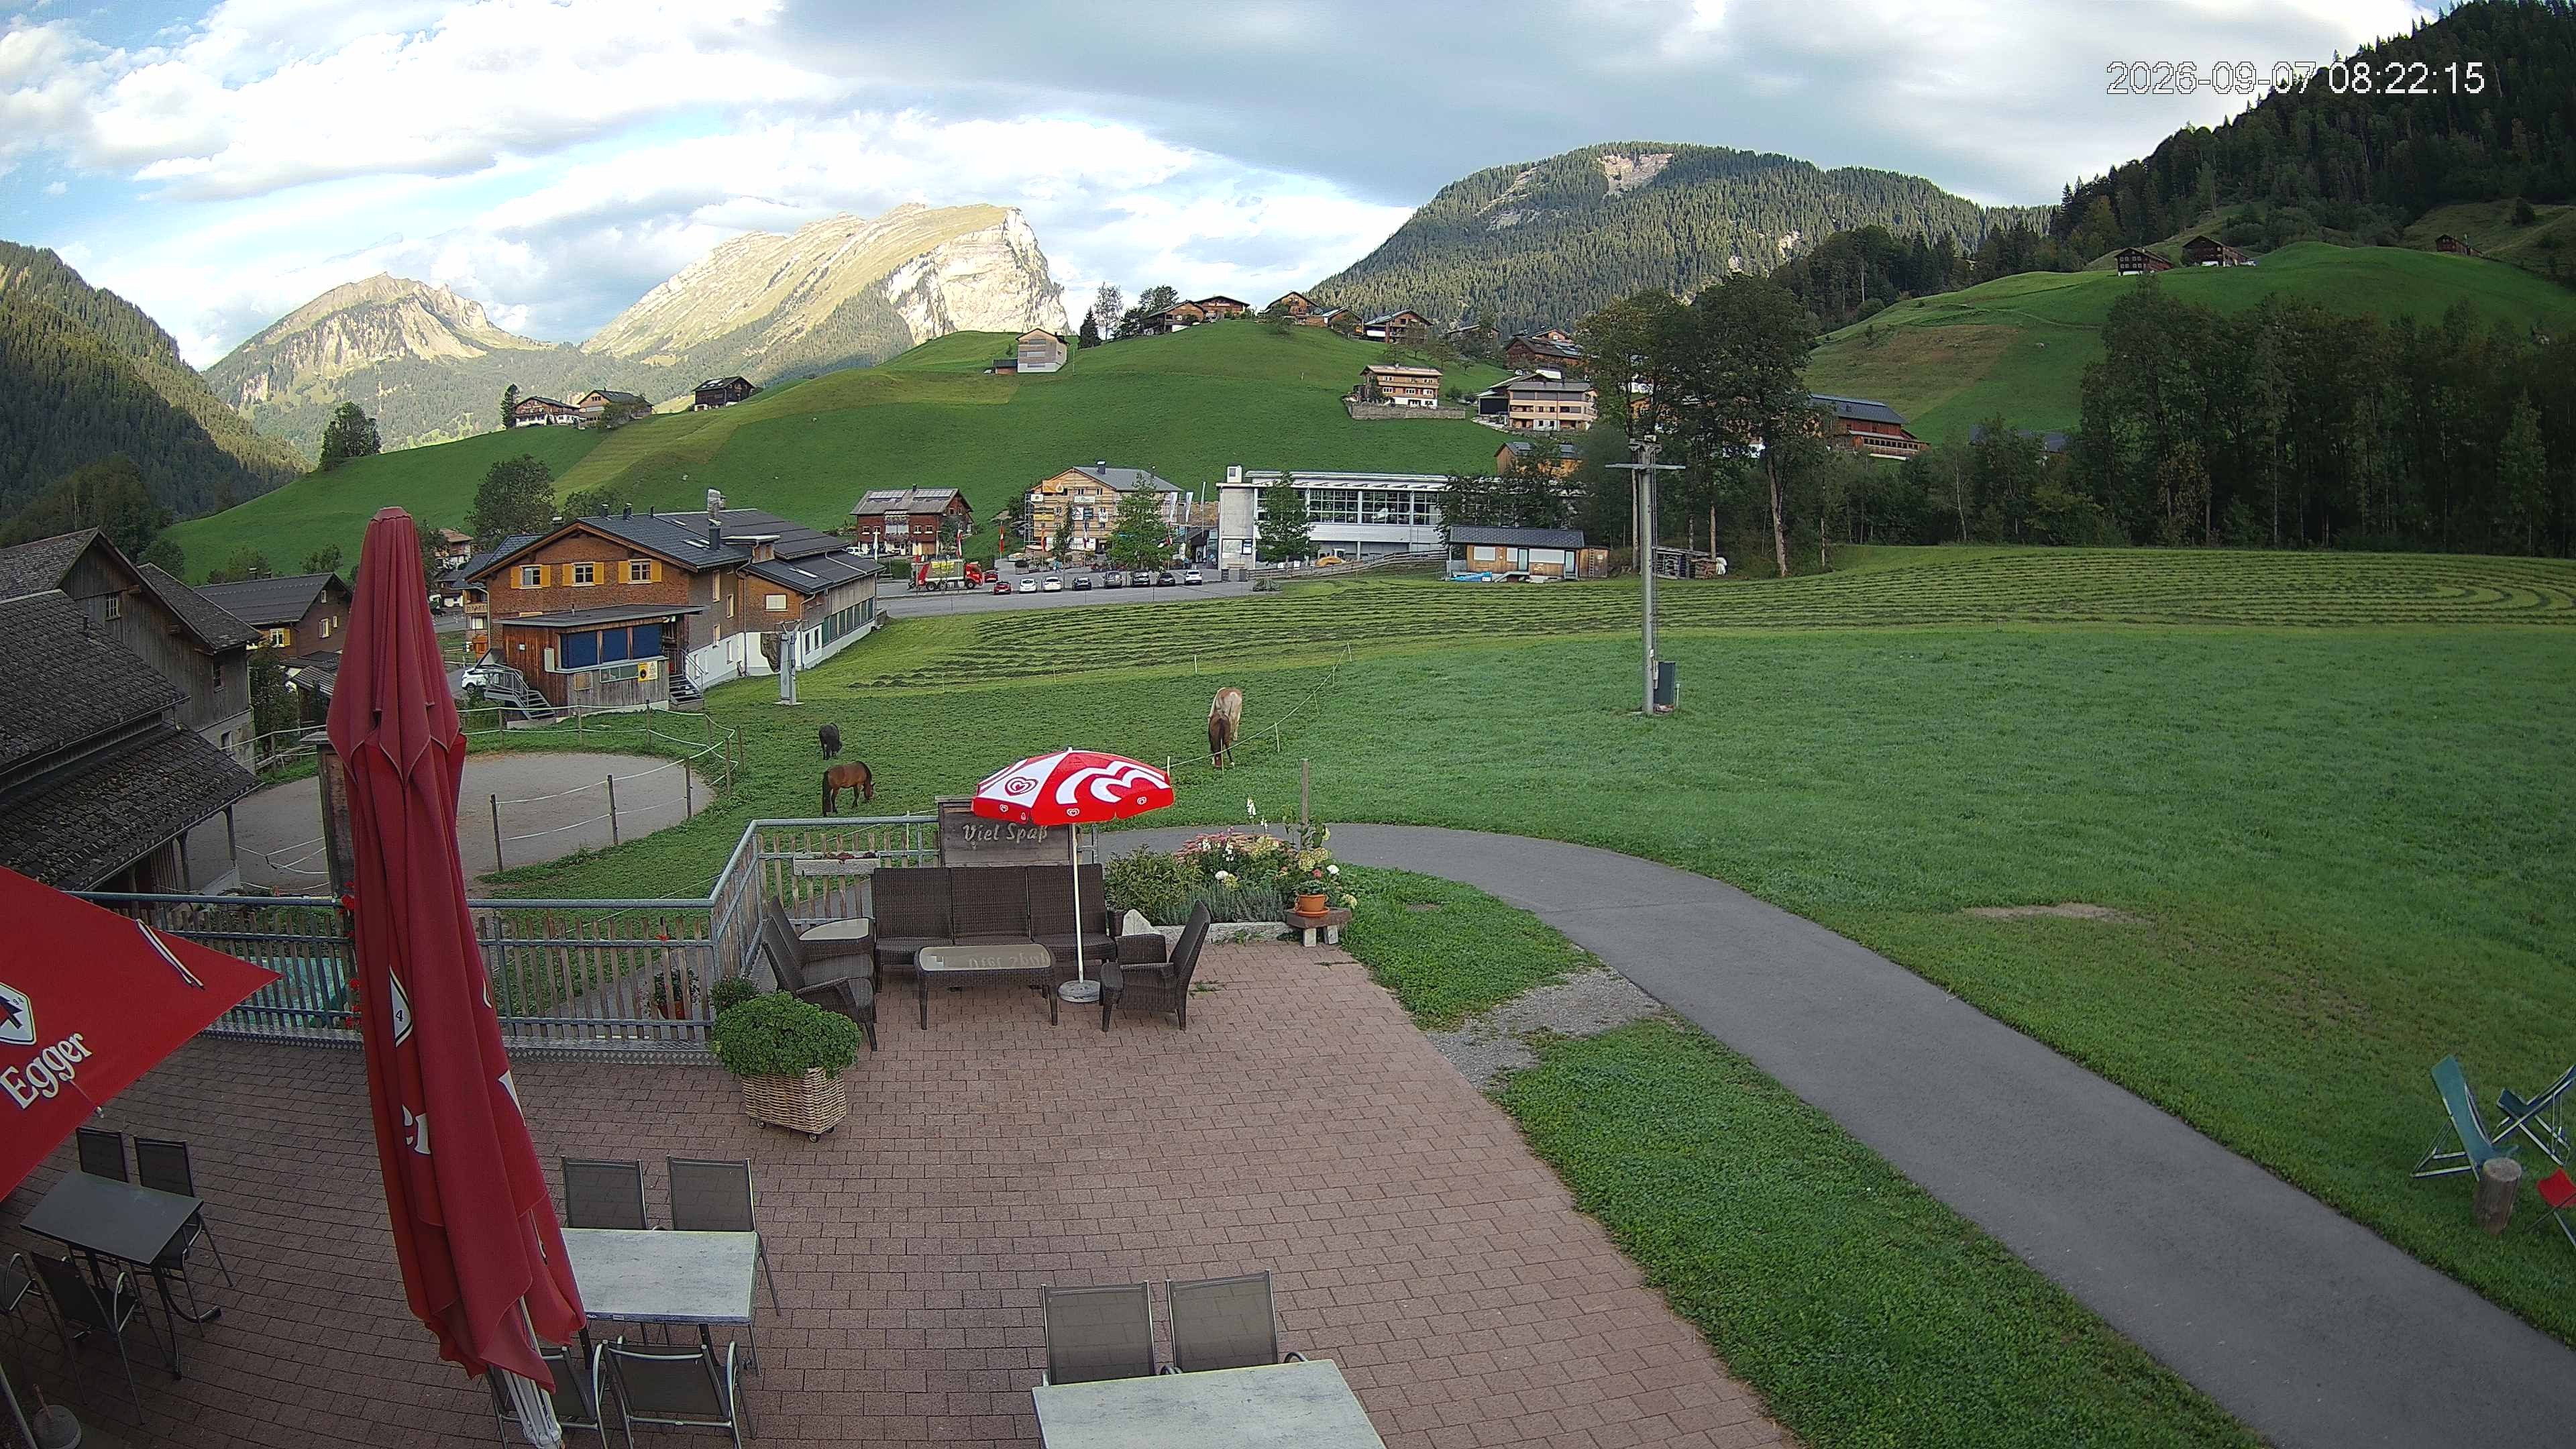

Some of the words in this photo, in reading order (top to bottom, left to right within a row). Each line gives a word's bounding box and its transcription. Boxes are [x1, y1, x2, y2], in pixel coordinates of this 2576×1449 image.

[963, 824, 1000, 841] Viel
[1006, 822, 1048, 843] Spaß
[0, 1033, 93, 1109] Egger
